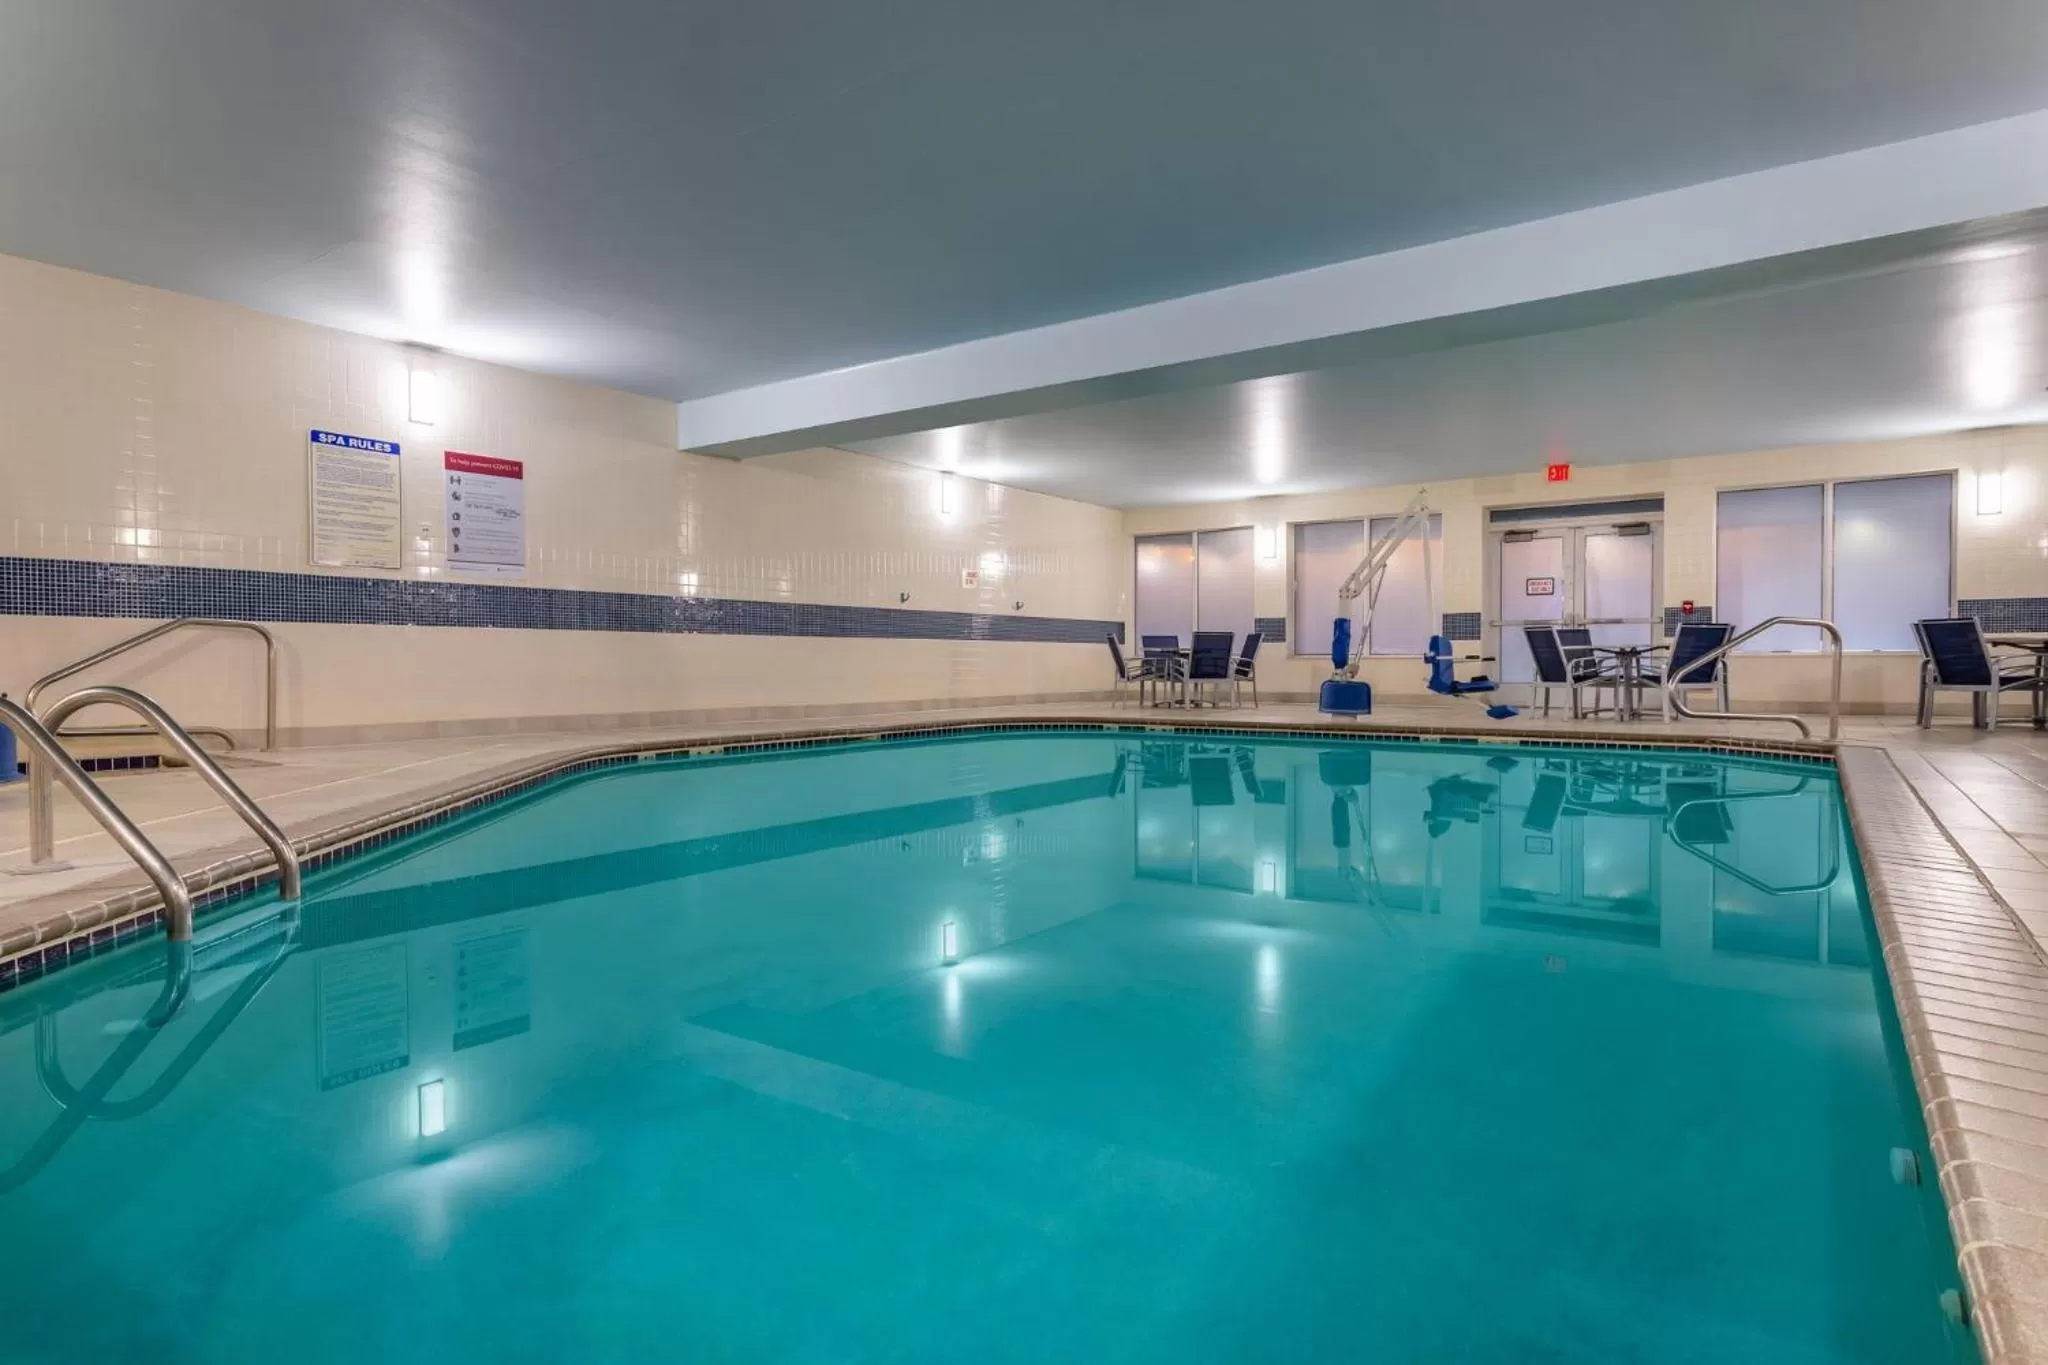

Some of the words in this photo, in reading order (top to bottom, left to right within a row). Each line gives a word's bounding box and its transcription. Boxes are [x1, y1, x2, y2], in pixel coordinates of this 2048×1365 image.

[318, 433, 345, 446] SPA
[348, 438, 392, 453] RULES
[1548, 464, 1569, 480] EXIT
